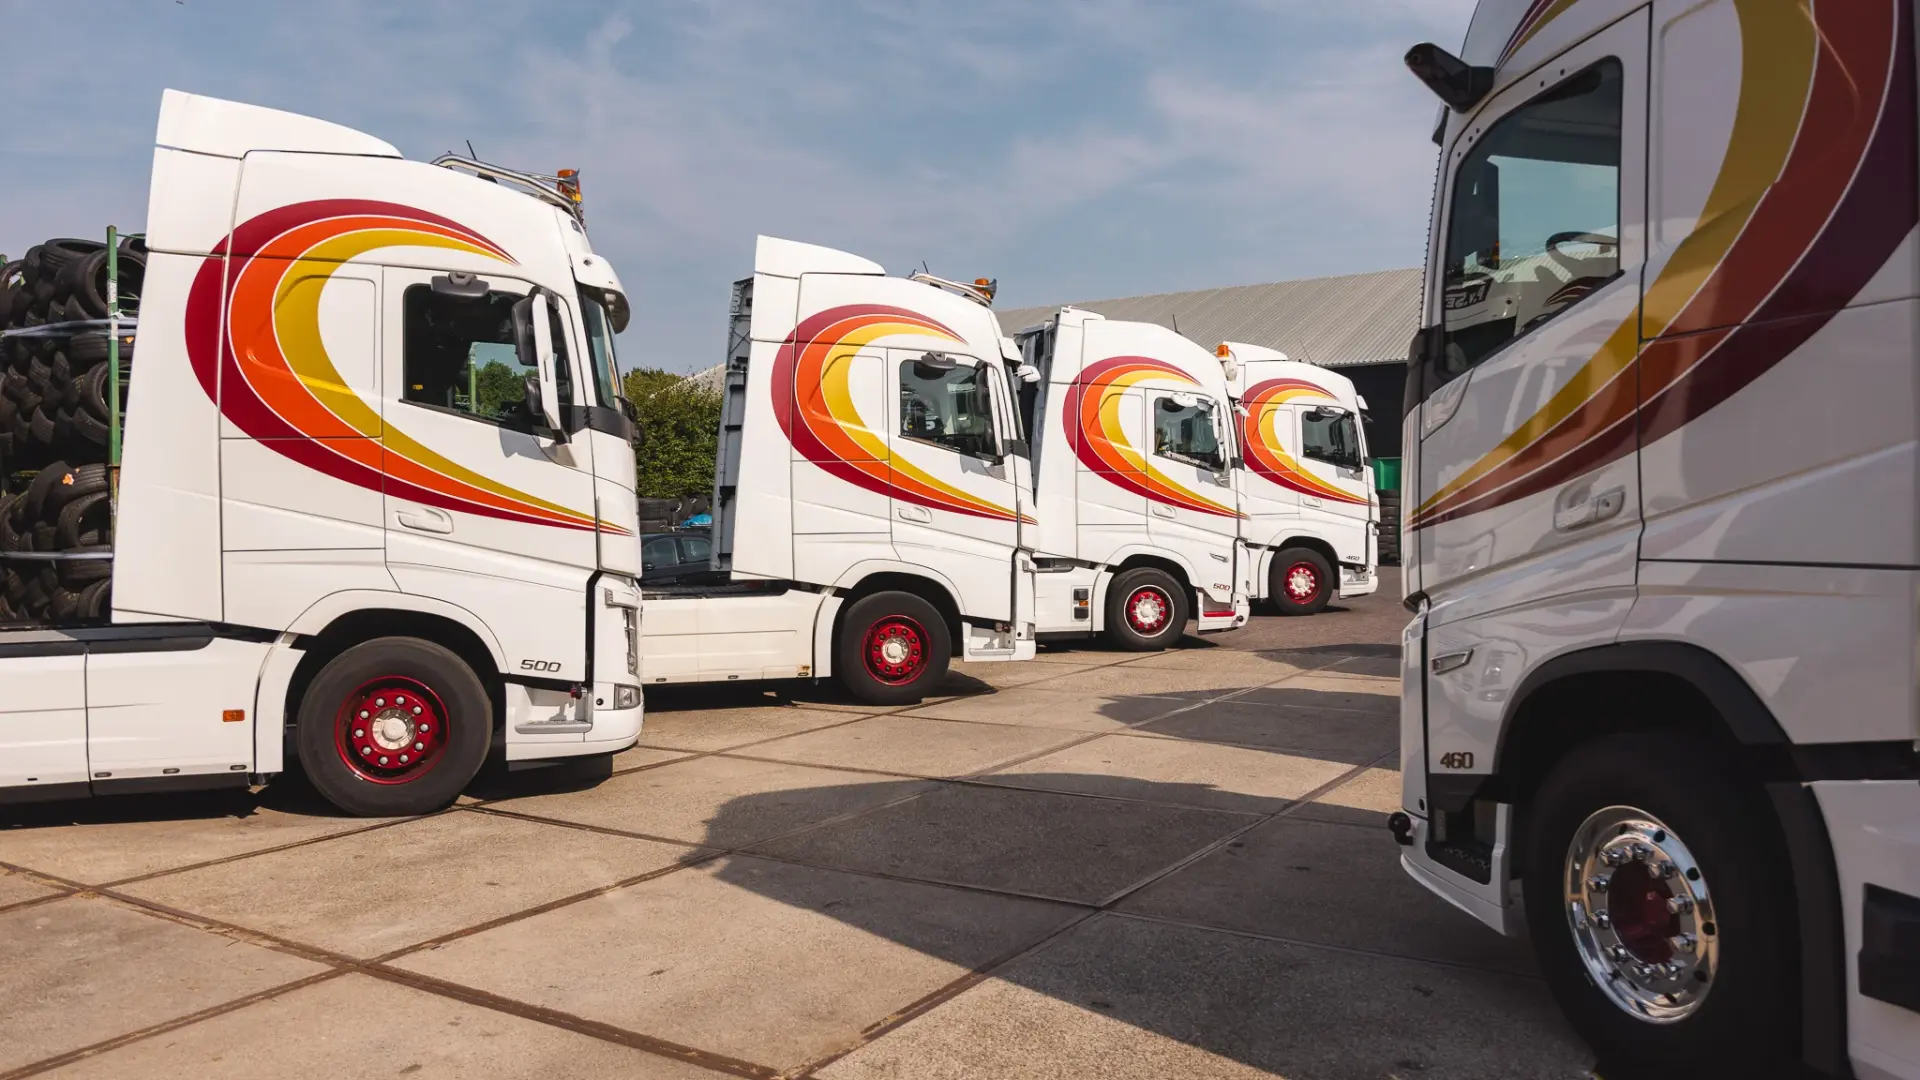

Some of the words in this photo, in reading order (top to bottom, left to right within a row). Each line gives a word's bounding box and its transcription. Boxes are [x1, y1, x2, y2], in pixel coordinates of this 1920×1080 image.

[1213, 583, 1231, 591] 500
[520, 659, 562, 673] 500
[1440, 751, 1474, 769] 460
